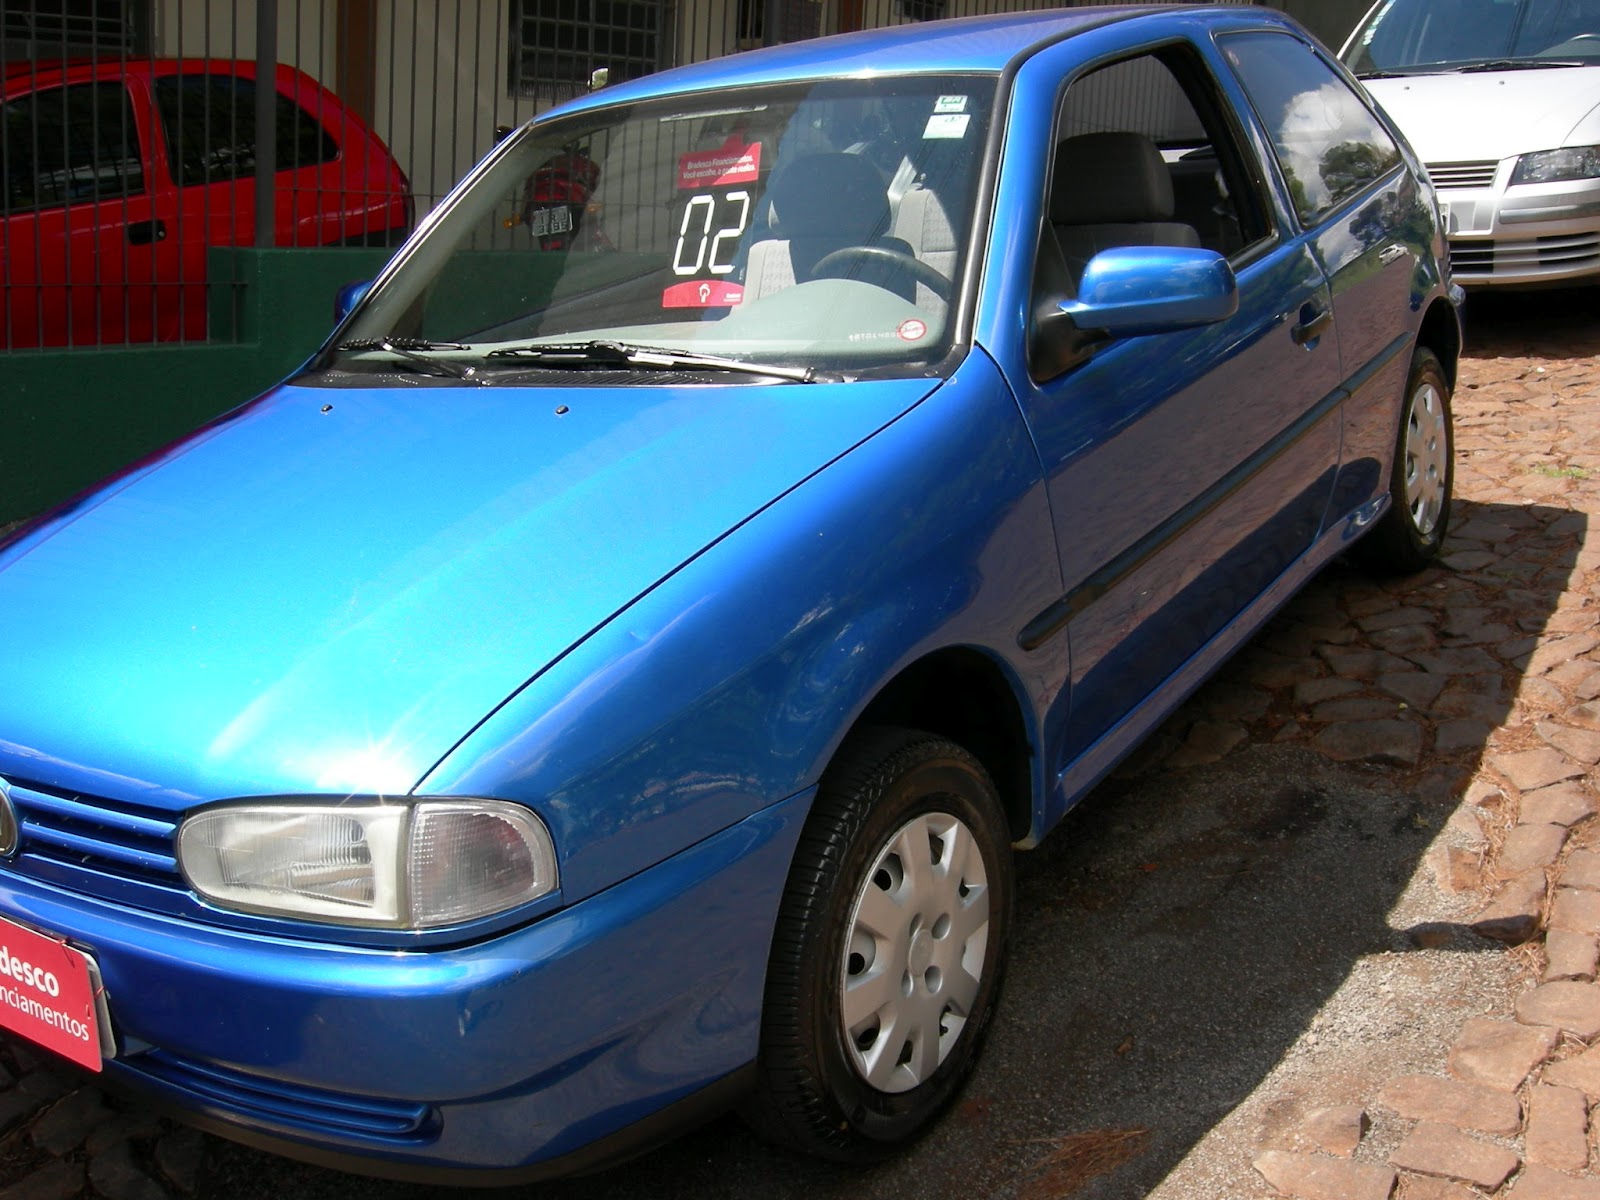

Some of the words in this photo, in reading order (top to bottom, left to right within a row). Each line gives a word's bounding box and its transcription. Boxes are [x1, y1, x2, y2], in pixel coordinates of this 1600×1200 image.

[672, 190, 750, 276] 02
[0, 945, 60, 998] desco
[0, 985, 90, 1042] nciamentos
